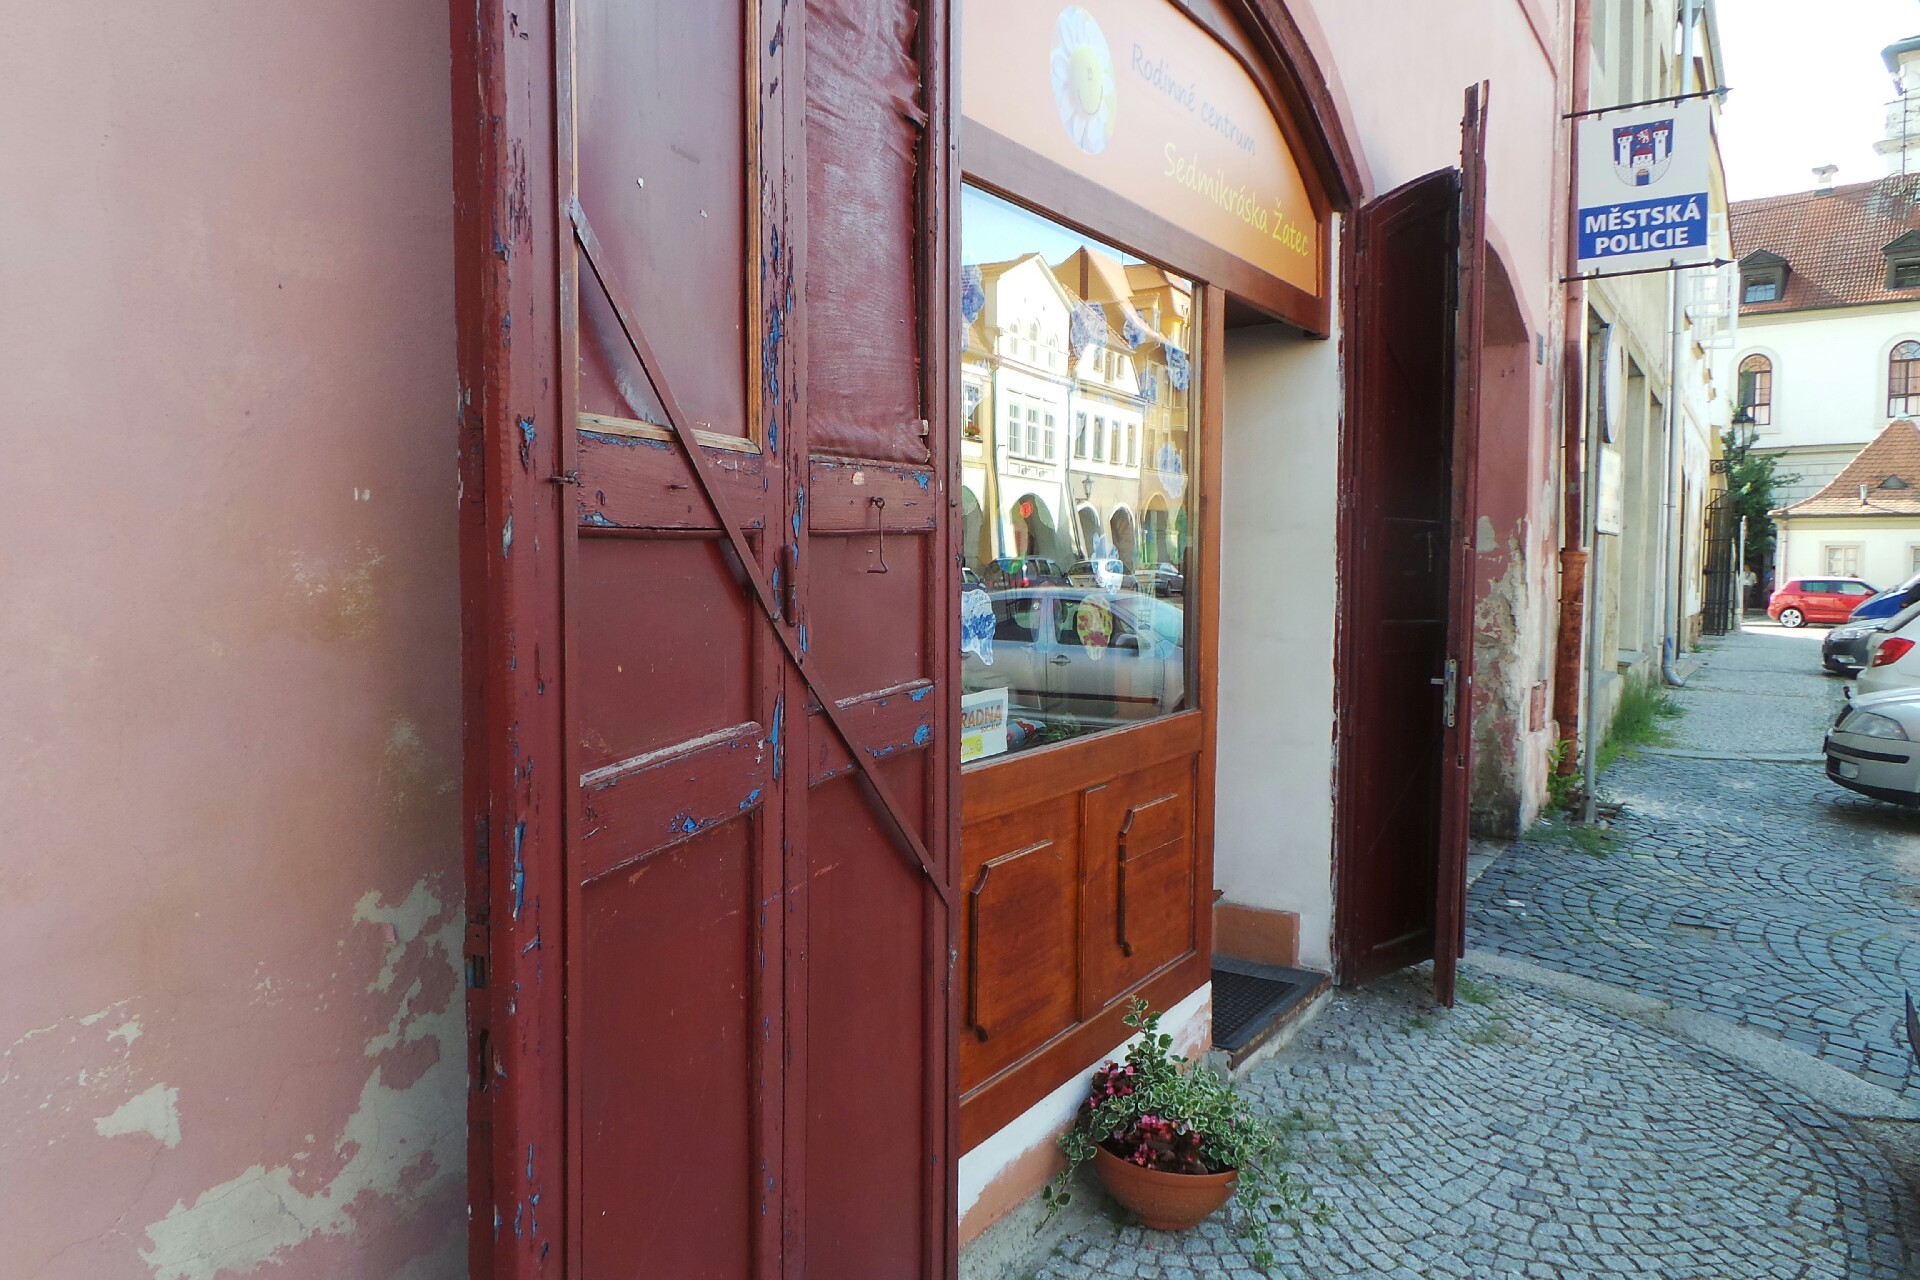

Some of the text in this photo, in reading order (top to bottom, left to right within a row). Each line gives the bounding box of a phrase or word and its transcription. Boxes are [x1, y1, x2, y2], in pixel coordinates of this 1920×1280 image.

[1132, 43, 1256, 156] Rodinné centrum
[1164, 142, 1309, 256] Sedmikráska Žatec
[1585, 197, 1701, 234] MĚSTSKÁ
[1595, 227, 1689, 255] POLICIE
